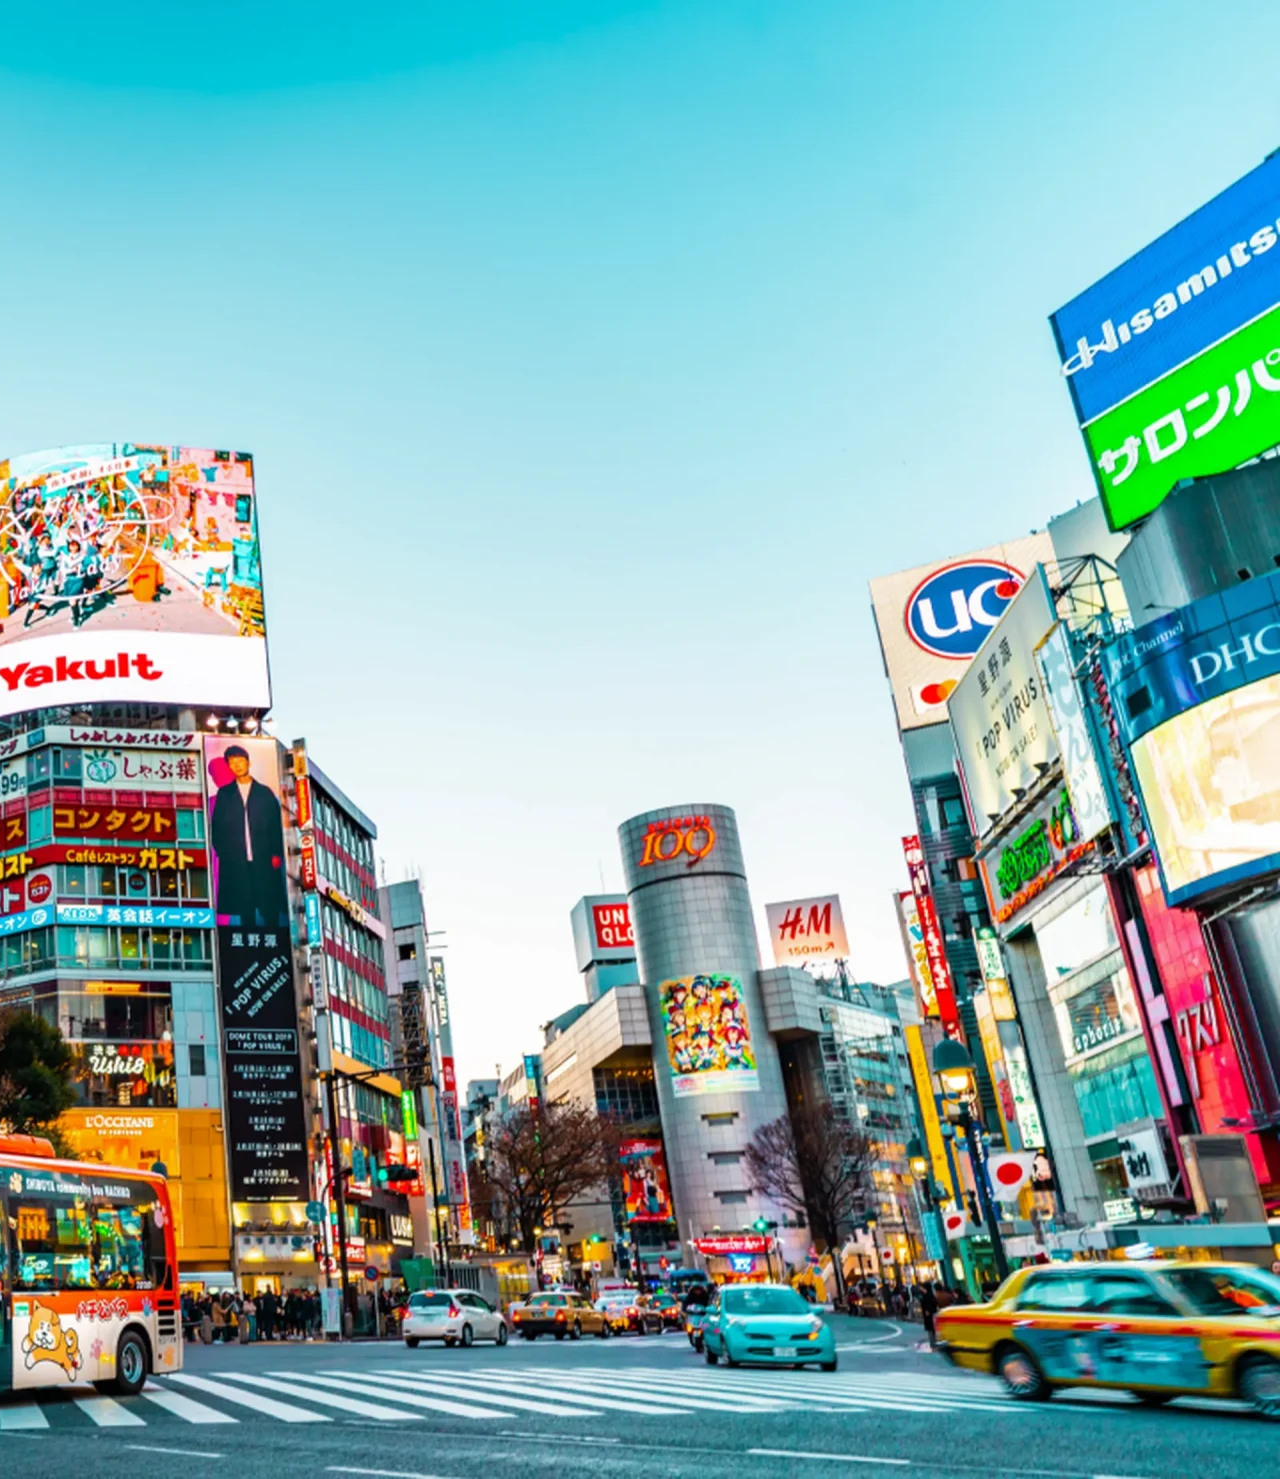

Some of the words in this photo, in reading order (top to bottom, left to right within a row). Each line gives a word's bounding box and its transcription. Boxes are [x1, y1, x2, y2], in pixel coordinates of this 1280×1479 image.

[1060, 217, 1280, 376] Hisamits
[1189, 622, 1280, 685] DHC
[123, 756, 196, 781] しゃぶ葉
[54, 809, 171, 833] コンタクト
[638, 824, 716, 868] 109
[139, 848, 195, 870] ガスト
[107, 908, 211, 924] 英会話イーオン
[778, 902, 832, 940] H&M
[85, 1114, 154, 1128] L'OCCITANE
